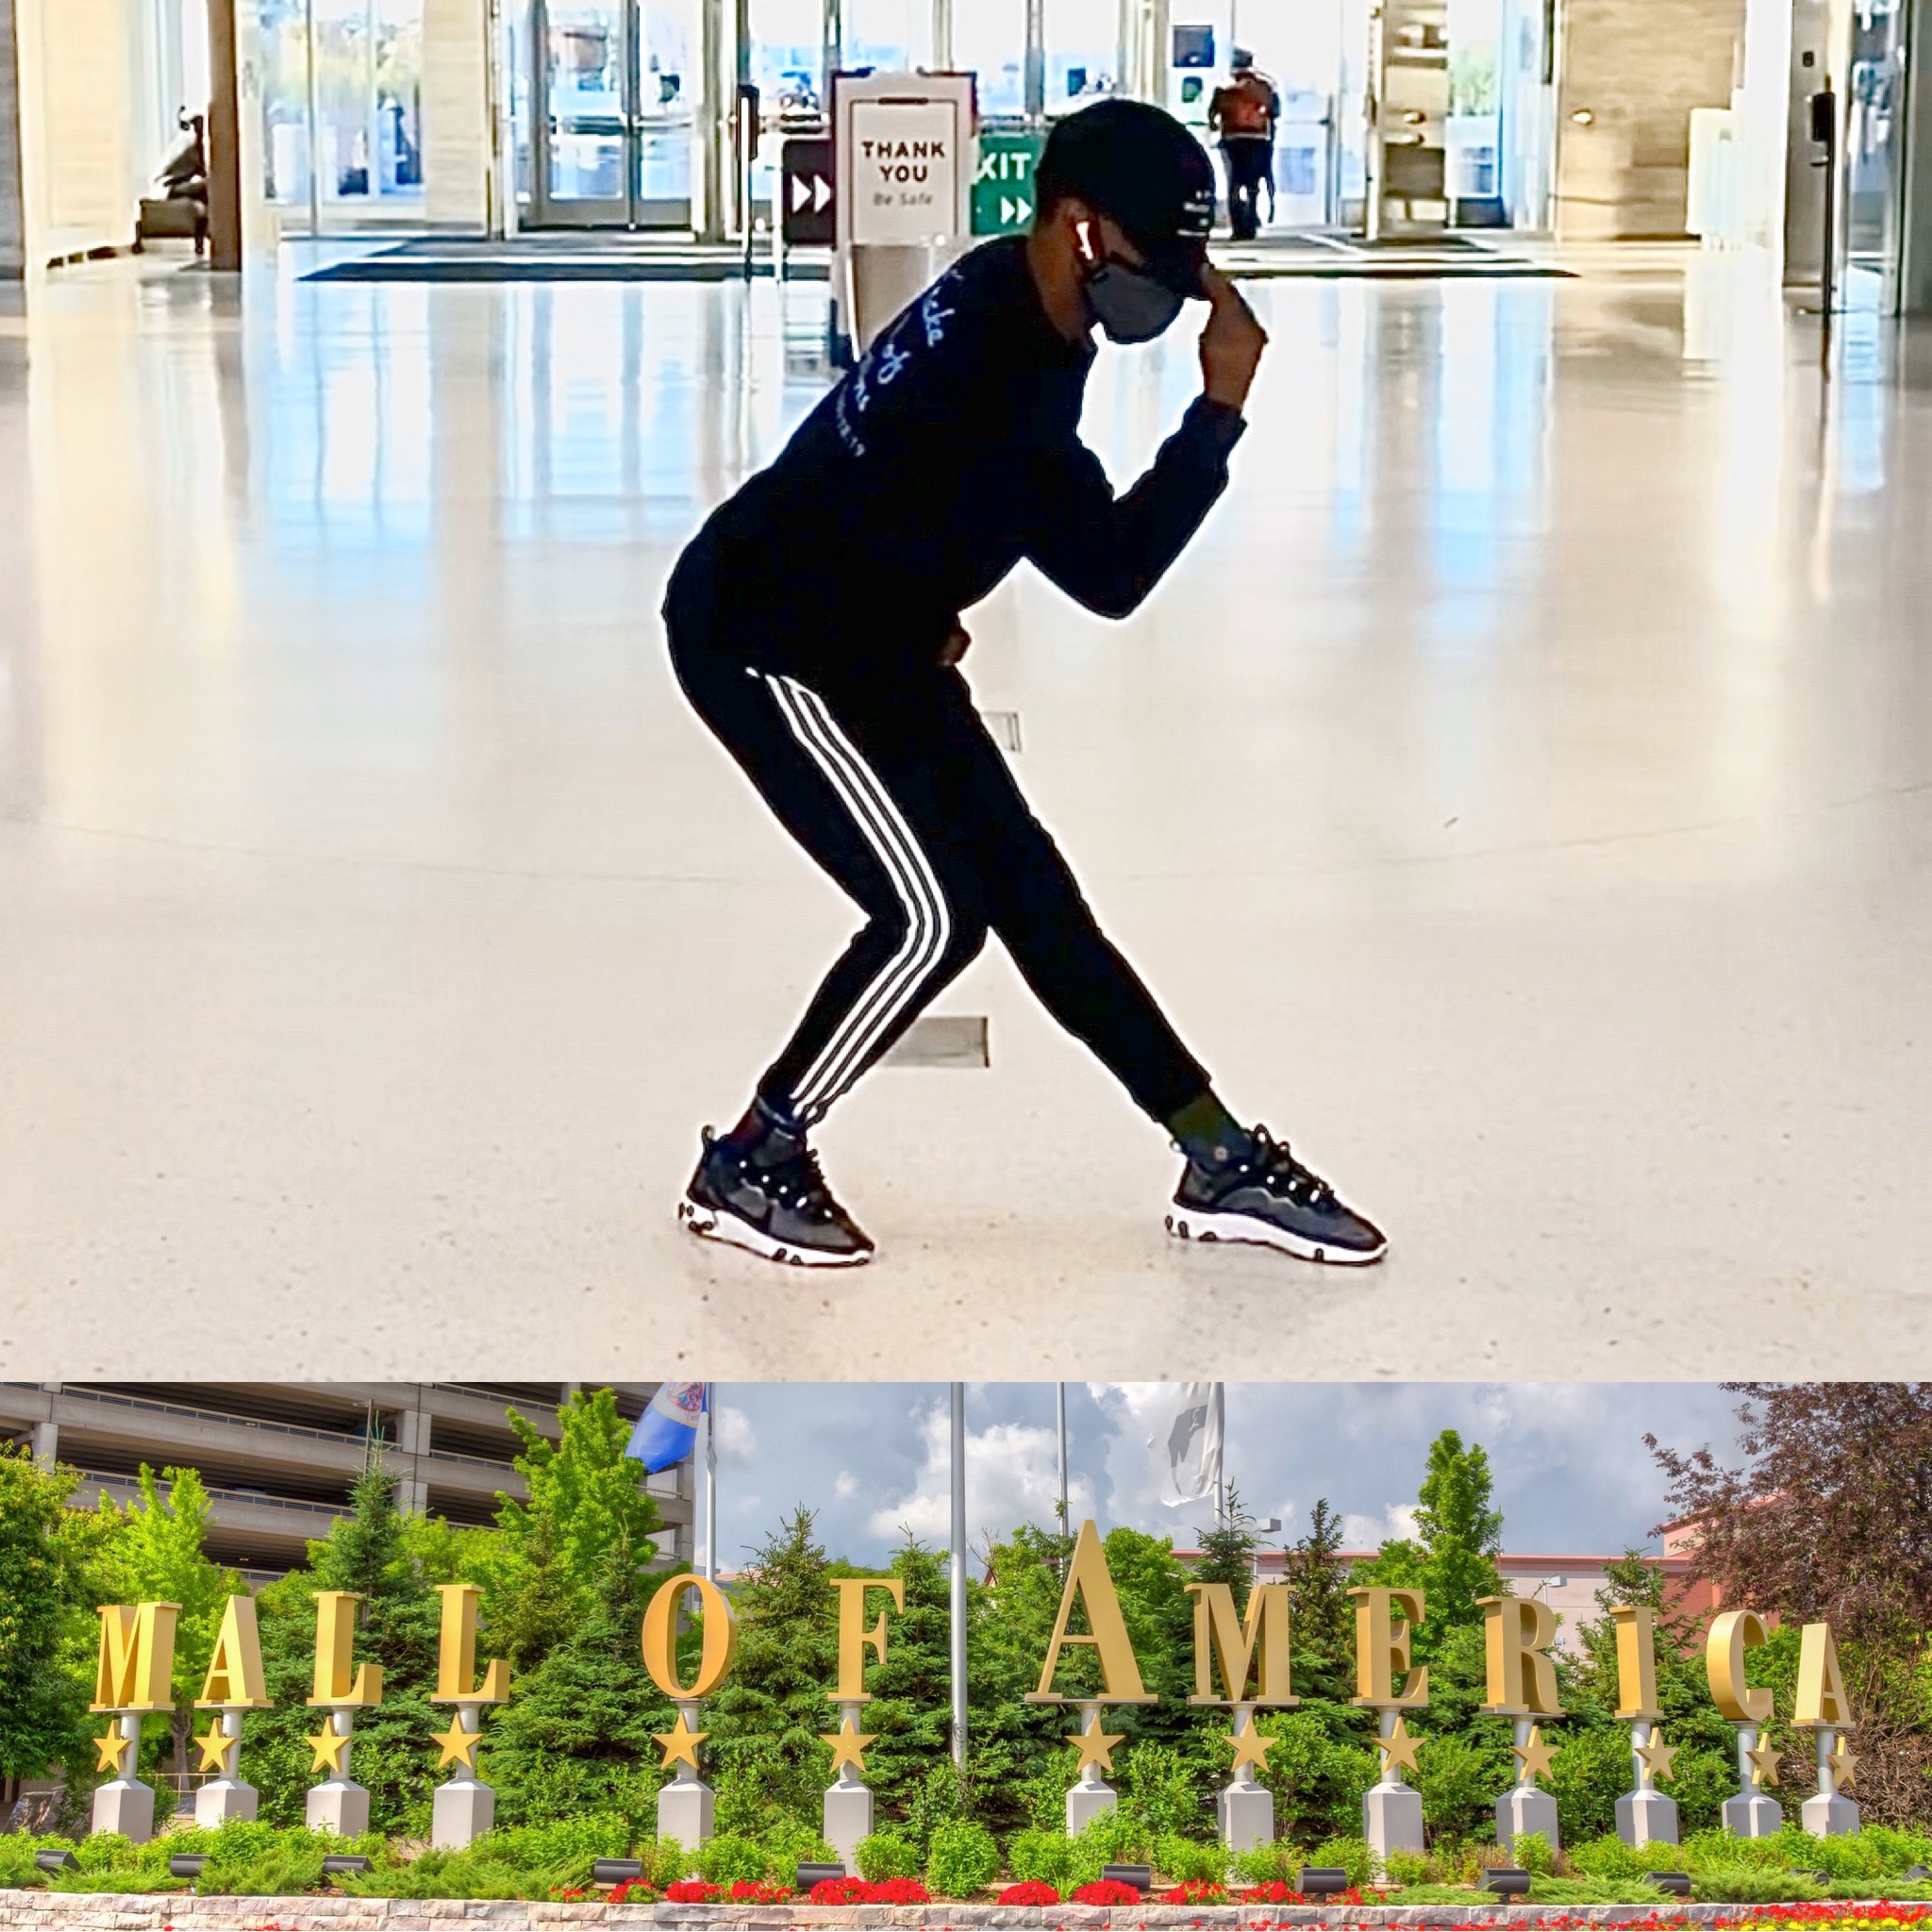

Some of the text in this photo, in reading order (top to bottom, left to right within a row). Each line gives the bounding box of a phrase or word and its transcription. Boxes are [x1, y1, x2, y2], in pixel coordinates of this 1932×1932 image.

[861, 142, 945, 158] THANK
[879, 165, 928, 182] YOU
[978, 152, 1033, 180] XIT
[873, 191, 933, 206] Be Safe
[90, 1520, 1857, 1727] MALL OF AMERICA
